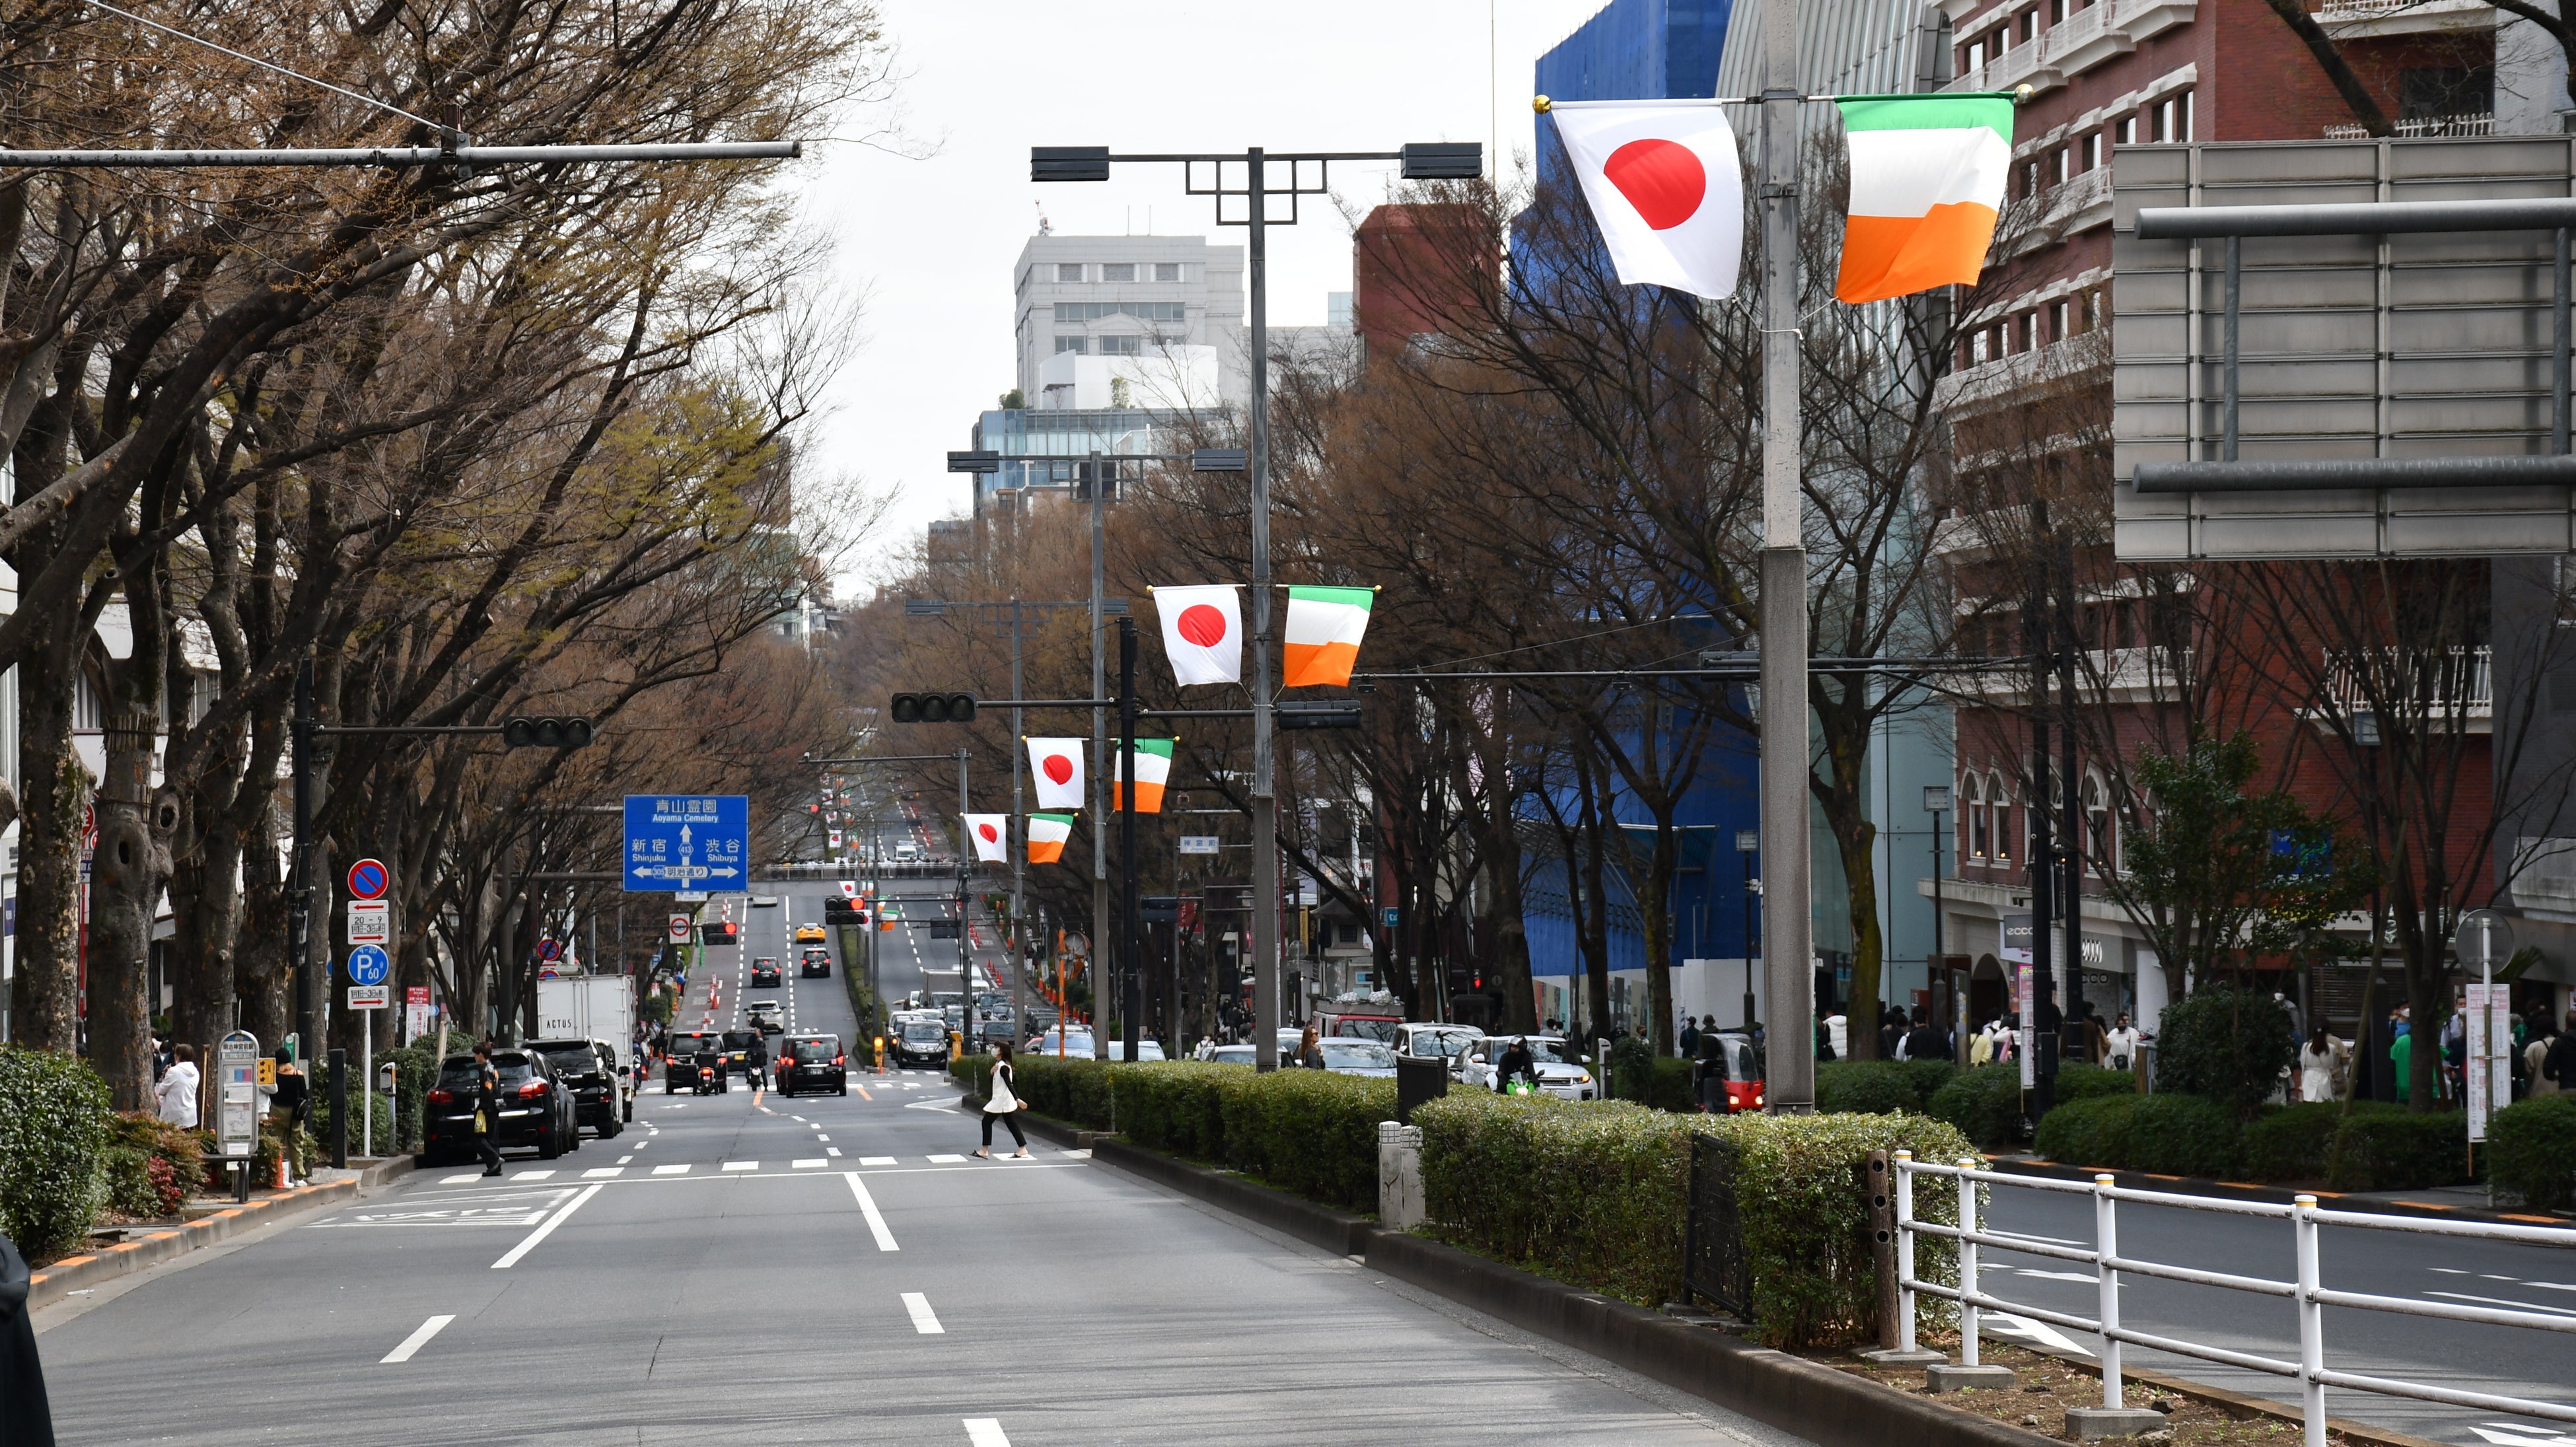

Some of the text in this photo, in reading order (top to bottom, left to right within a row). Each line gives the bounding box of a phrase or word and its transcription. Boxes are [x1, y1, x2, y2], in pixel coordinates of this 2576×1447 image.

[656, 799, 717, 813] 青山霊園
[653, 814, 719, 824] Aoyama Cemetery
[631, 838, 666, 853] 新宿
[705, 838, 740, 853] 渋谷
[632, 853, 666, 863] Shinjuku
[707, 853, 738, 863] Shibuya
[653, 868, 664, 876] 305
[667, 867, 704, 877] 明治通り
[377, 915, 382, 924] 9
[357, 954, 373, 980] P
[368, 968, 379, 979] 60
[2082, 973, 2109, 983] cco
[546, 1019, 572, 1028] ACTUS
